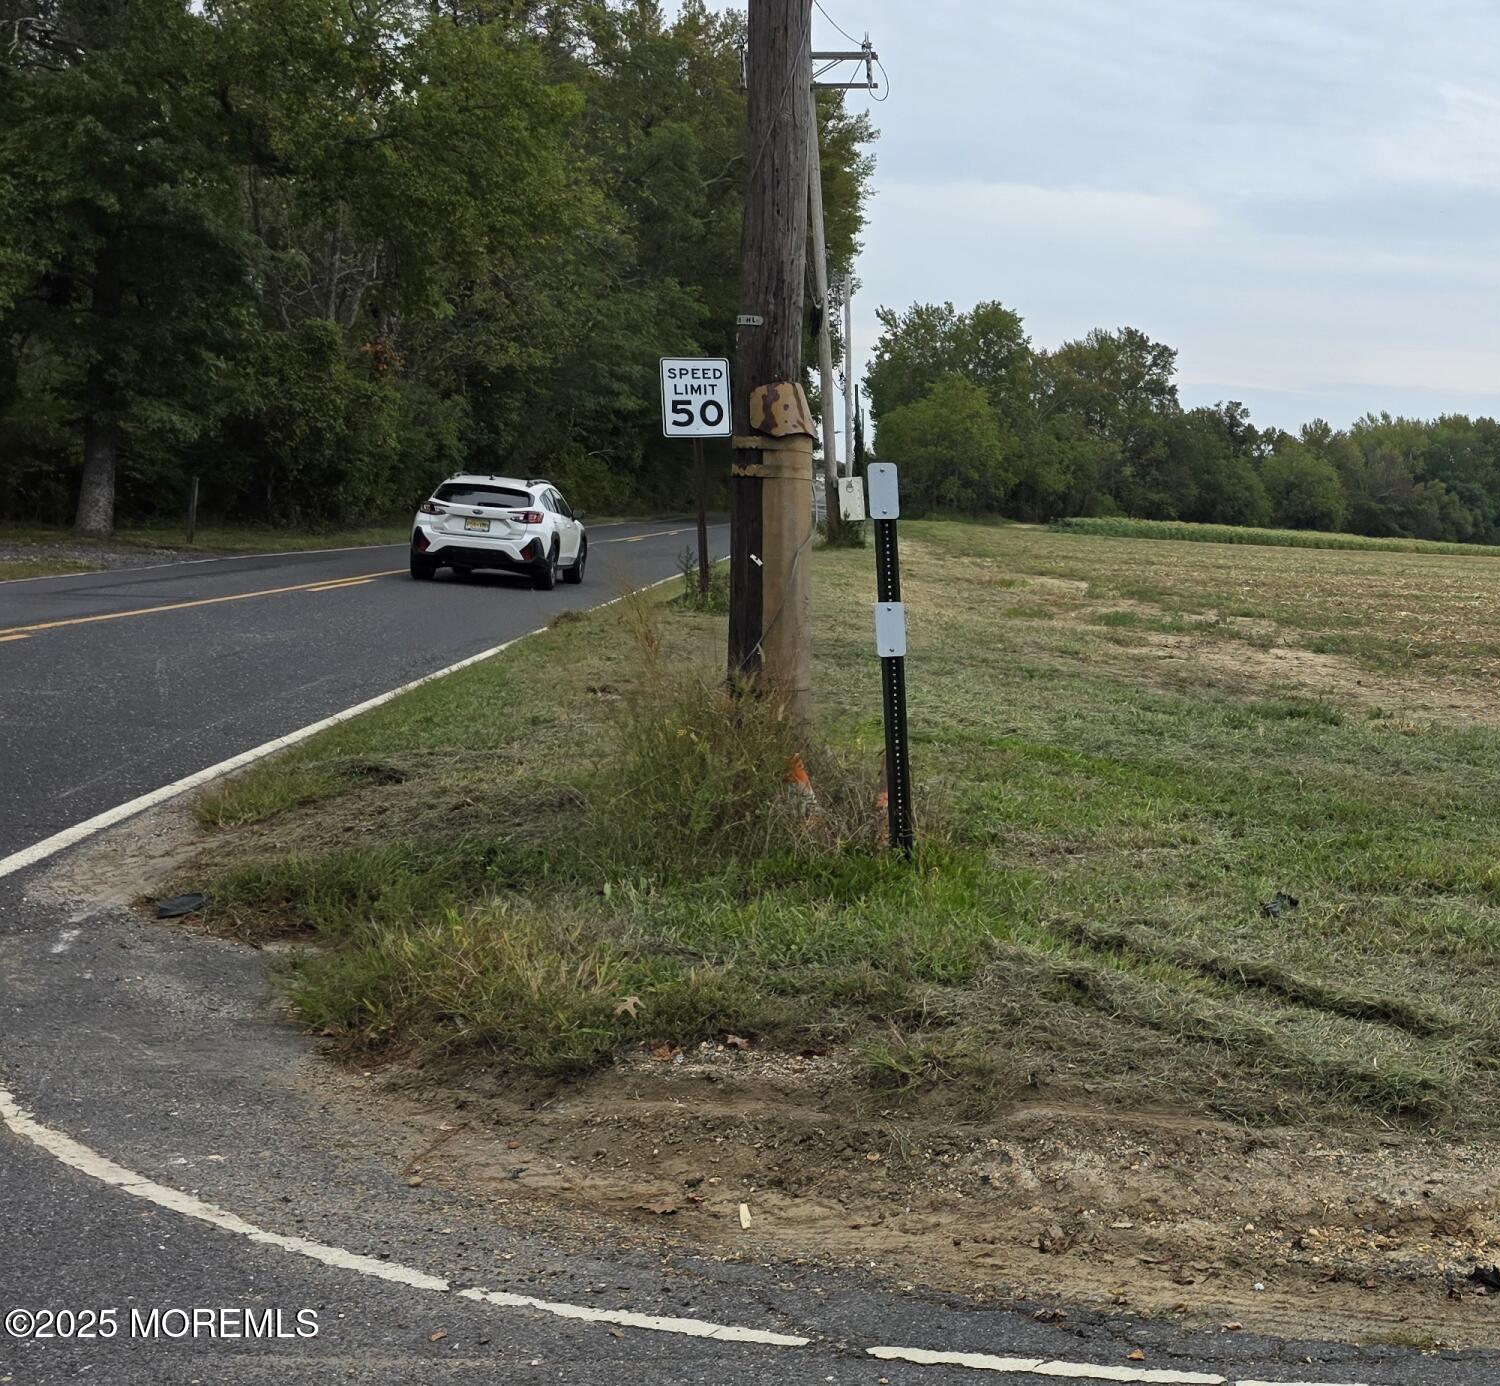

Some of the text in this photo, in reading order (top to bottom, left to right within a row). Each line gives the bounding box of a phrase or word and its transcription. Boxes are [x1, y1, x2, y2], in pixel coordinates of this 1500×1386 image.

[667, 367, 723, 380] SPEED
[673, 383, 718, 396] LIMIT
[671, 399, 724, 427] 50
